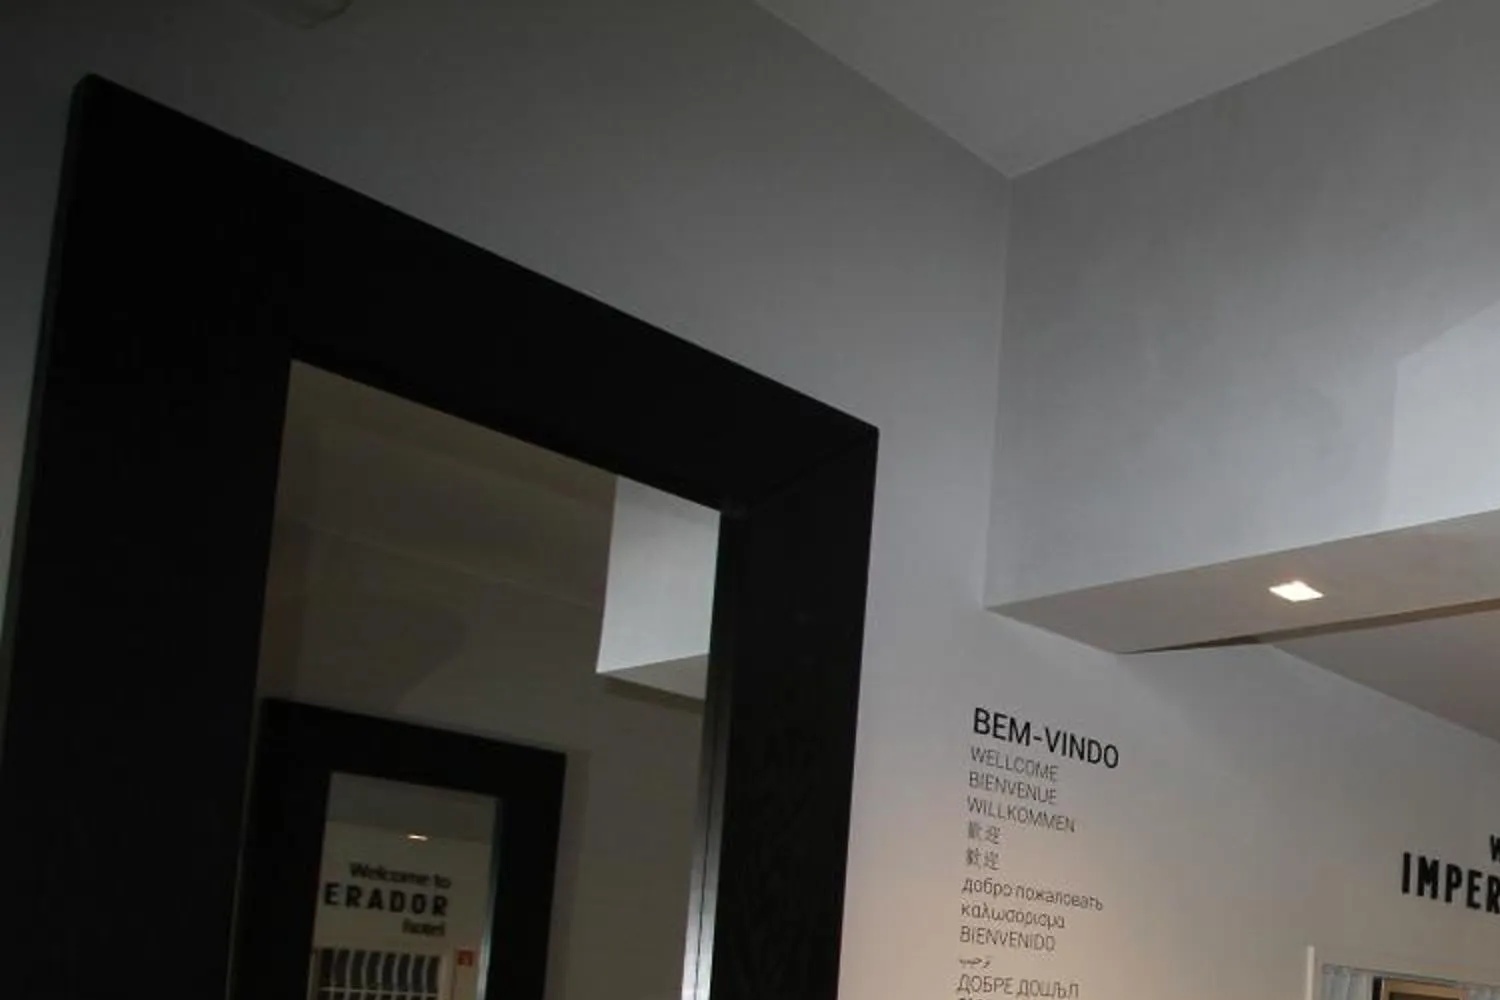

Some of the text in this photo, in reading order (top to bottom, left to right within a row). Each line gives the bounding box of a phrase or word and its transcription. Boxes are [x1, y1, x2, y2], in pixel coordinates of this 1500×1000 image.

[972, 707, 1119, 769] BEM-VINDO
[970, 747, 1059, 783] WELLCOME
[969, 771, 1057, 805] BIENVENUE
[967, 797, 1075, 833] WILLKOMMEN
[961, 878, 1104, 912] добро пожаловать
[960, 925, 1056, 952] BIENVENIDO
[957, 973, 1013, 996] ДОБРЕ
